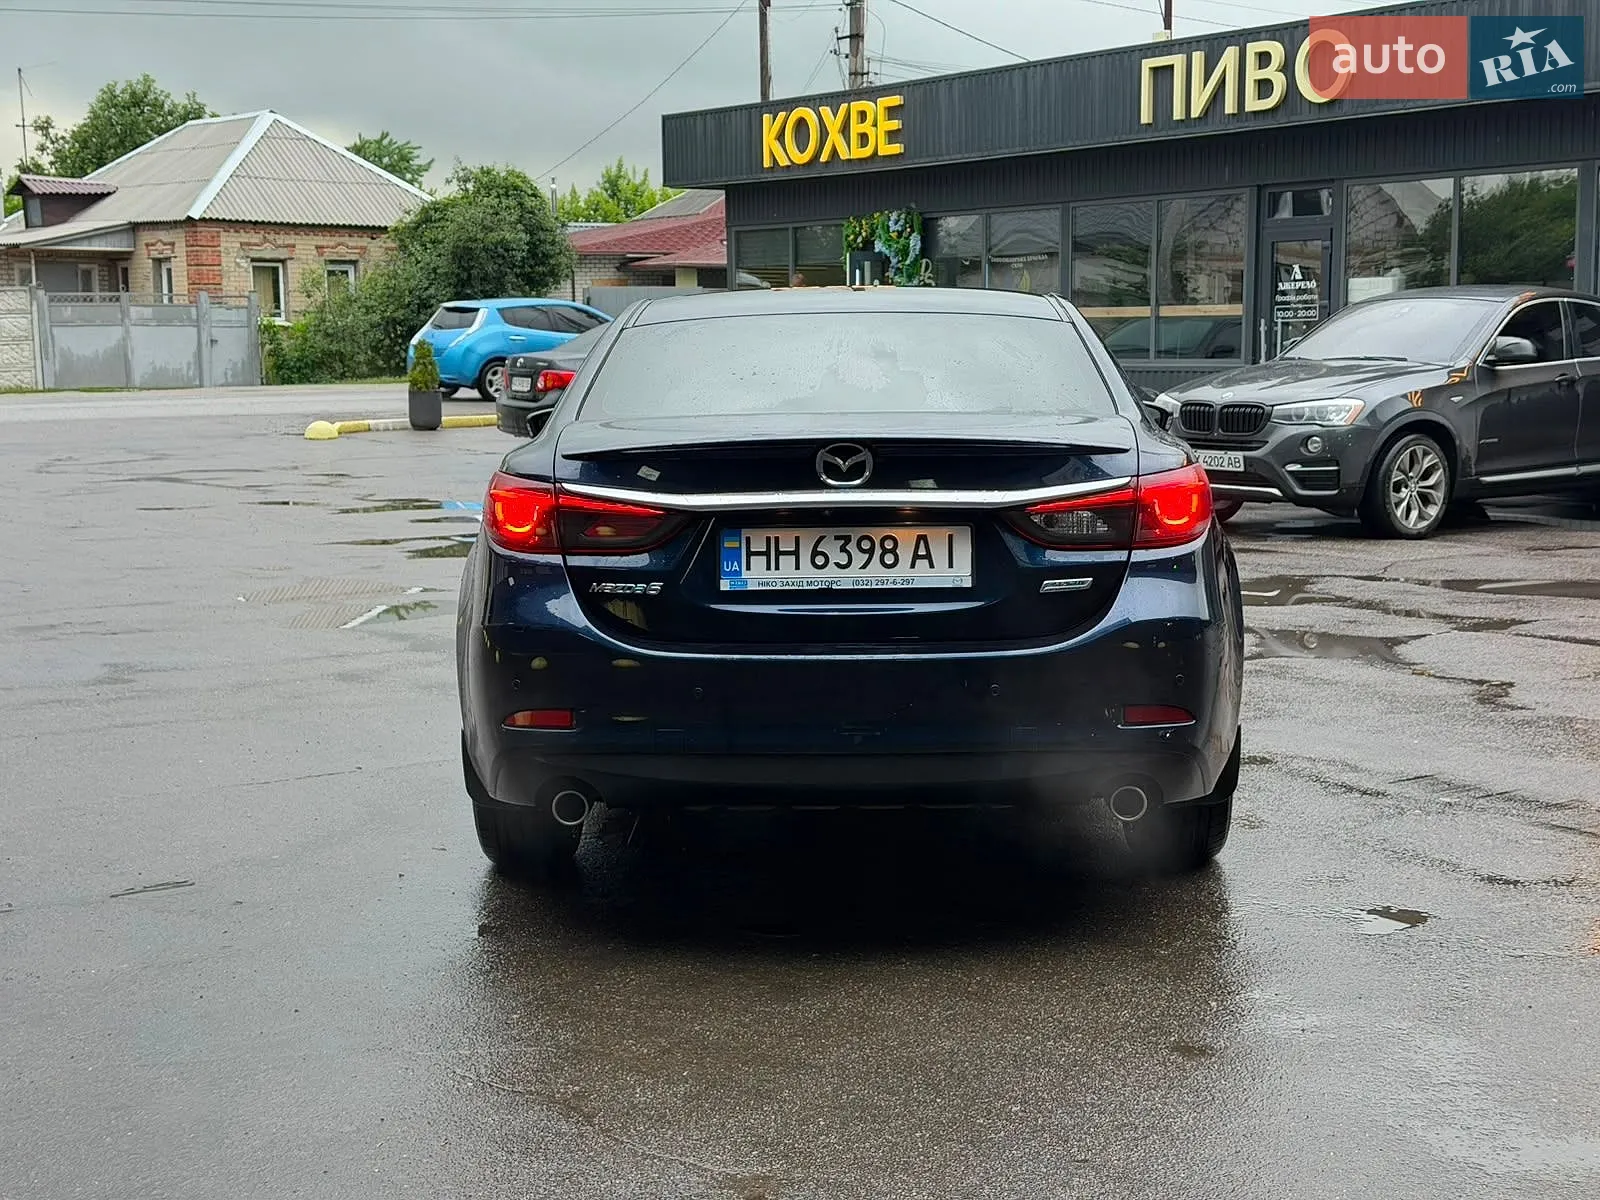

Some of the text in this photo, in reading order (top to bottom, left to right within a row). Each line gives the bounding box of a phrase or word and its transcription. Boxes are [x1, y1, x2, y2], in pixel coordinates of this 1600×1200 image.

[1140, 28, 1352, 125] ПИВО
[762, 95, 904, 169] КОХВЕ
[1202, 455, 1226, 468] 4202
[1227, 456, 1242, 469] AB
[744, 535, 801, 571] HH
[809, 533, 900, 570] 6398
[723, 561, 740, 572] UA
[757, 580, 777, 588] НІКО
[779, 579, 804, 588] ЗАХІД
[806, 579, 842, 588] МОТОРС
[852, 578, 916, 589] (032) 297-6-297
